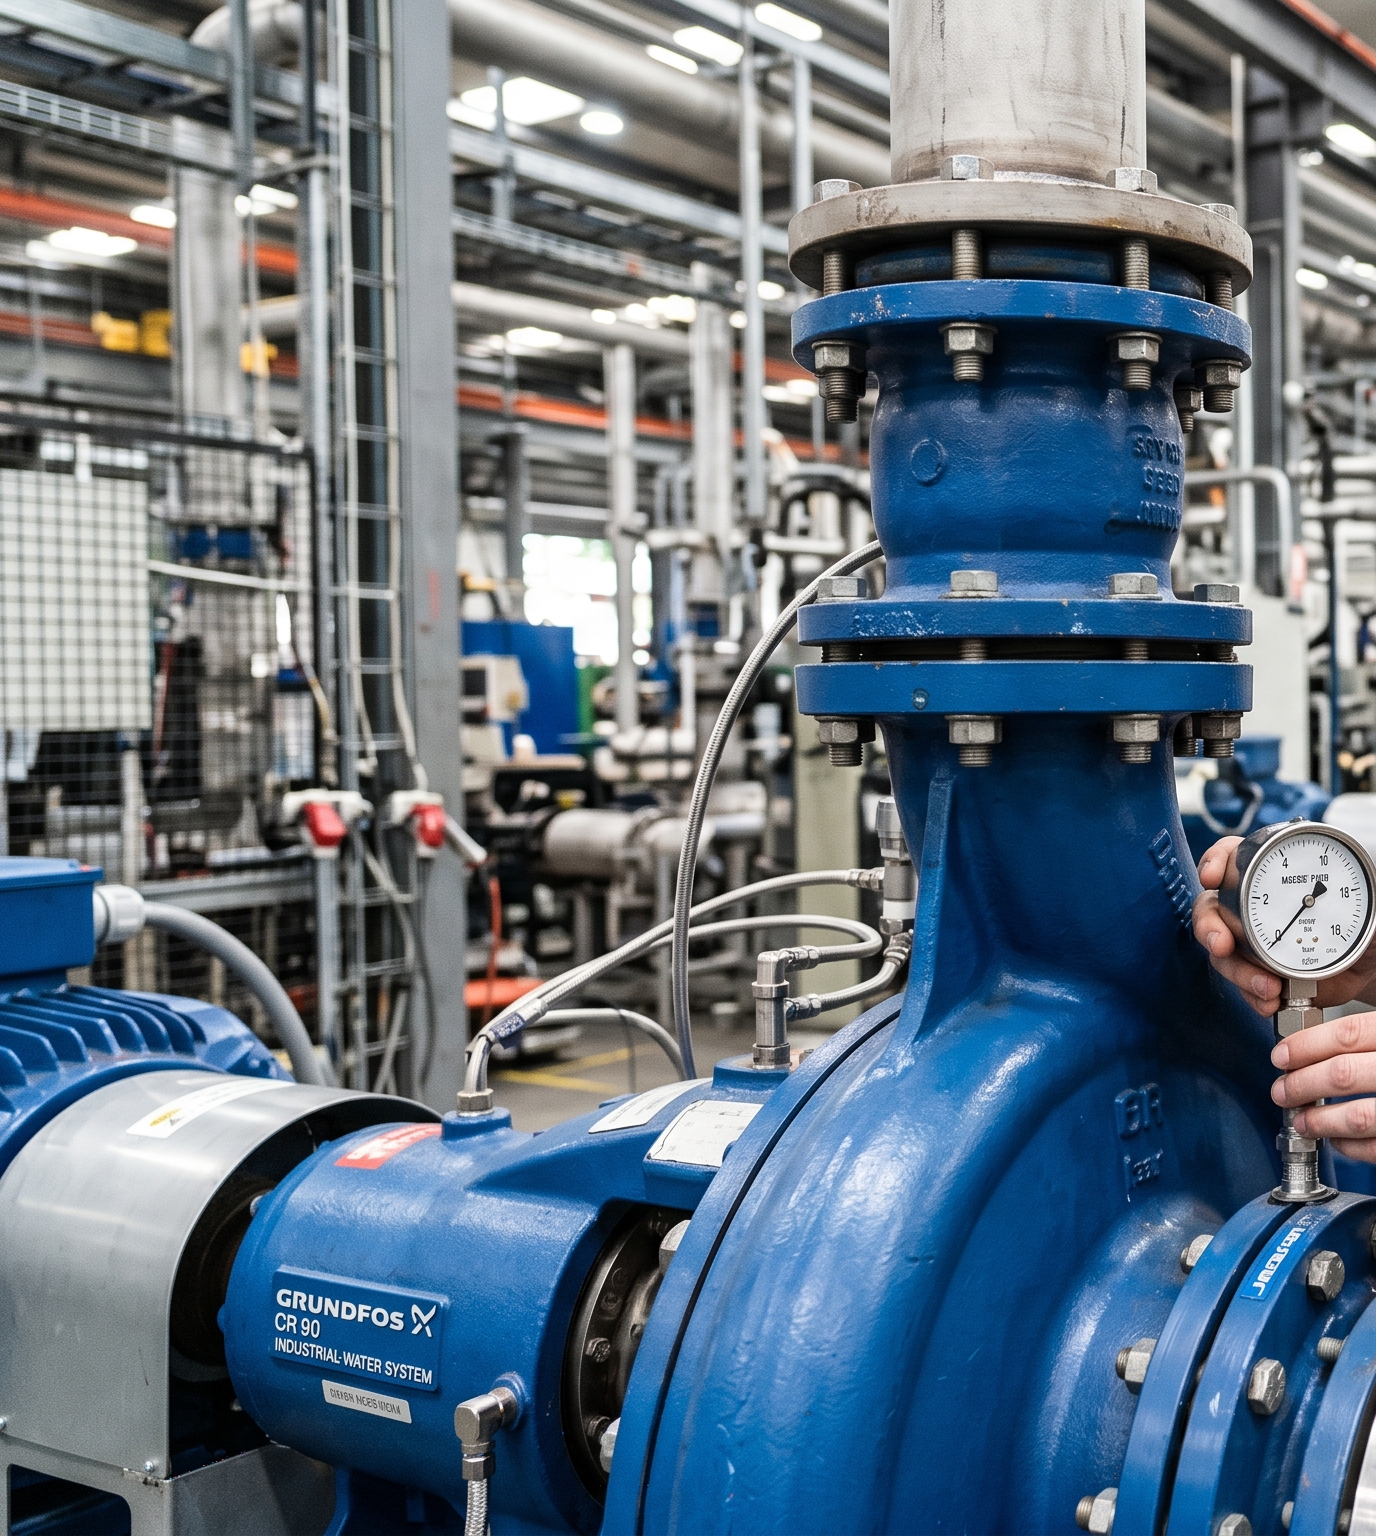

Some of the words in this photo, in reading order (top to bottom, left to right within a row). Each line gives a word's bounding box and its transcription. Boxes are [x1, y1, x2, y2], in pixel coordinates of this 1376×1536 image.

[1282, 857, 1289, 869] 4
[1319, 854, 1329, 866] 10
[1339, 887, 1350, 898] 18
[1263, 893, 1269, 905] 2
[276, 1288, 405, 1331] GRUNDFOS
[274, 1312, 298, 1334] CR
[300, 1317, 321, 1339] 90
[384, 1360, 433, 1385] SYSTEM
